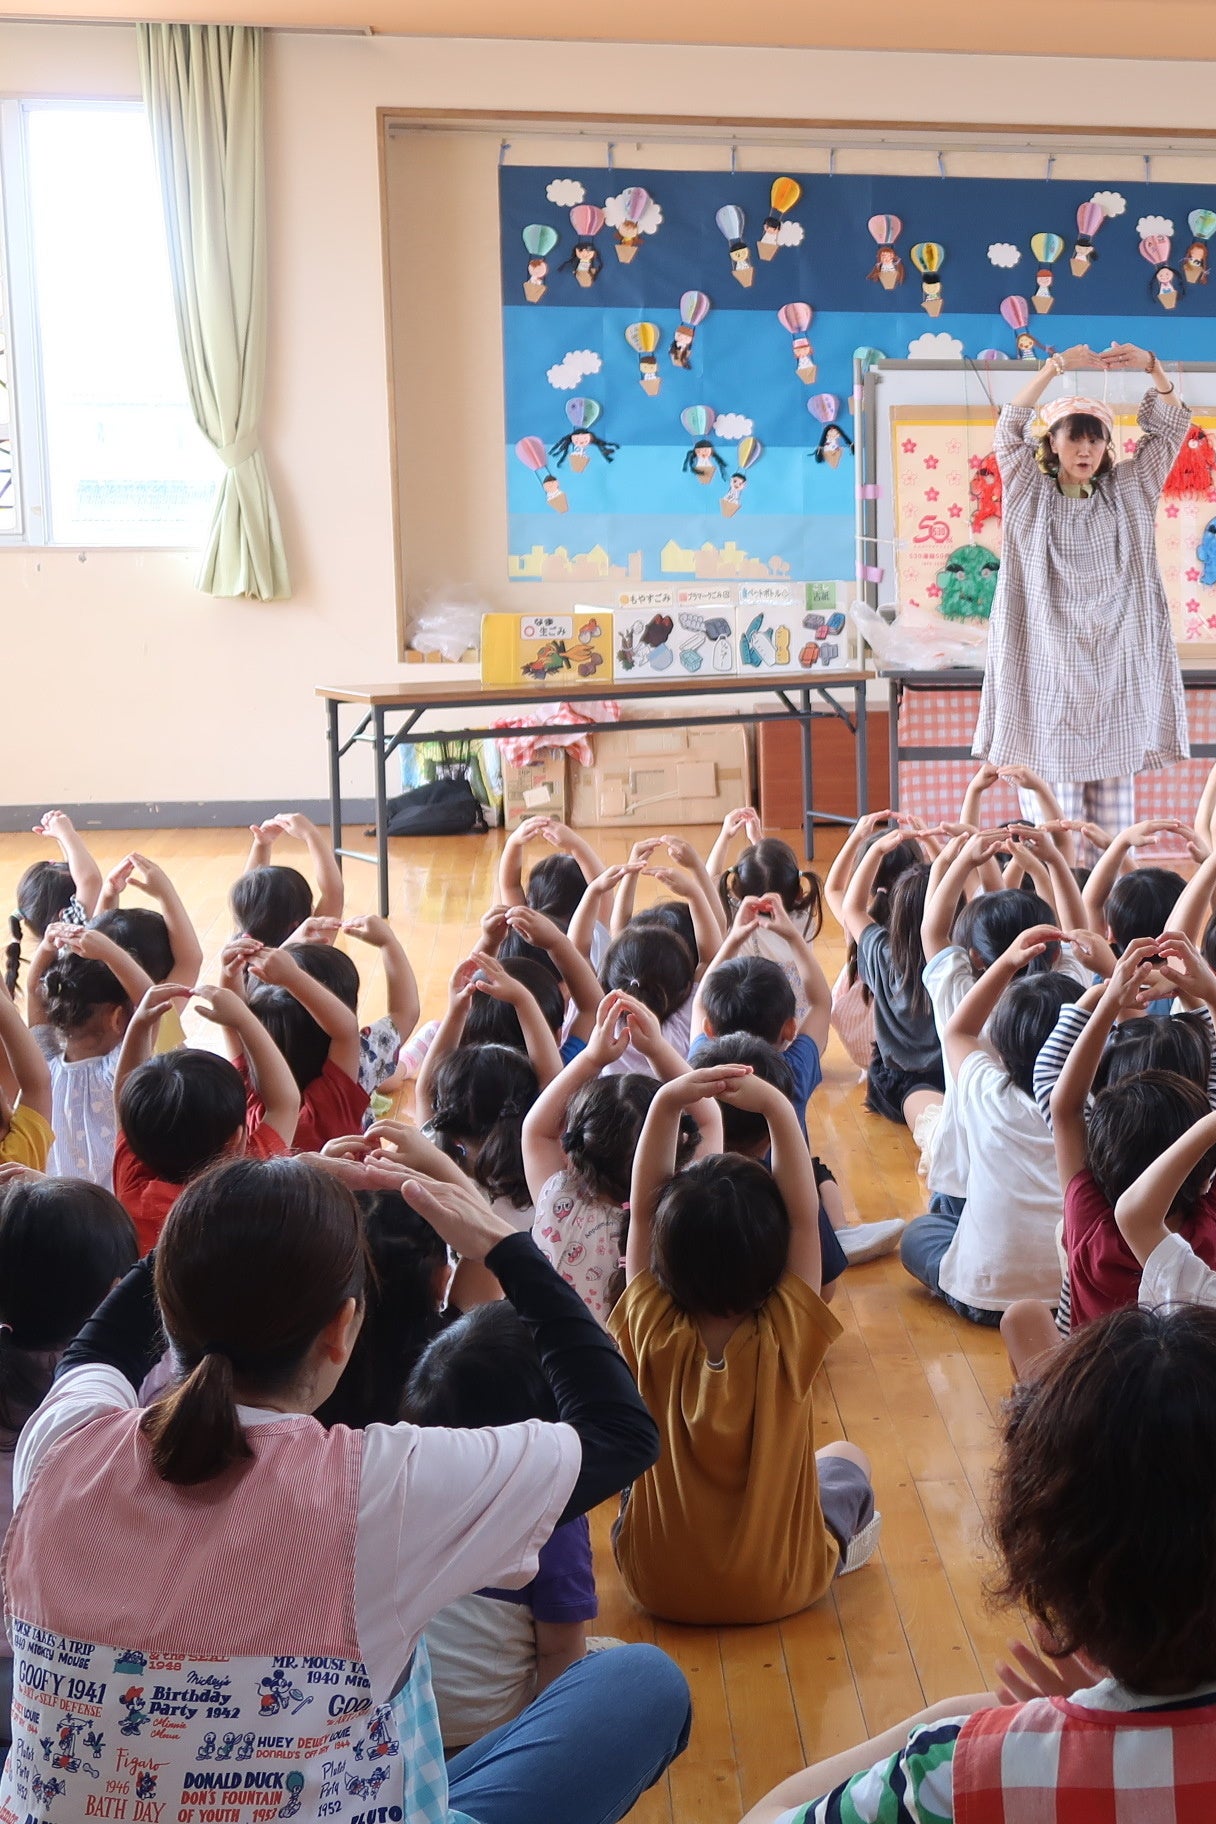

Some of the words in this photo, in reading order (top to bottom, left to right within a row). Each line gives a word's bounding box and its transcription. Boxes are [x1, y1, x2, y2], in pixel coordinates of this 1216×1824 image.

[630, 593, 671, 604] もやすごみ
[539, 626, 566, 637] 生ごみ
[32, 1628, 57, 1648] TAKES
[57, 1638, 66, 1651] A
[69, 1640, 96, 1656] TRIP
[27, 1641, 55, 1661] MICKEY
[58, 1652, 91, 1670] MOUSE
[301, 1656, 346, 1672] MOUSE
[148, 1661, 181, 1671] 1948
[20, 1660, 66, 1696] GOOFY
[67, 1678, 107, 1705] 1941
[187, 1670, 232, 1689] Mickey's
[307, 1671, 339, 1685] 1940
[150, 1685, 232, 1706] Birthday
[60, 1699, 103, 1718] DEFENSE
[148, 1701, 199, 1720] Party
[205, 1707, 241, 1719] 1942
[153, 1716, 187, 1729] Minnie
[150, 1728, 181, 1740] Mouse
[257, 1736, 294, 1748] HUEY
[297, 1734, 330, 1749] DEWEY
[329, 1726, 352, 1742] LOUIE
[116, 1747, 171, 1776] Figaro
[256, 1749, 301, 1759] DONALD'S
[105, 1780, 130, 1795] 1946
[183, 1772, 242, 1789] DONALD
[244, 1772, 285, 1789] DUCK
[181, 1790, 217, 1805] DON'S
[220, 1790, 283, 1806] FOUNTAIN
[85, 1794, 129, 1820] BATH
[132, 1800, 167, 1824] DAY
[177, 1808, 195, 1823] OF
[199, 1808, 241, 1823] YOUTH
[318, 1800, 343, 1817] 1952
